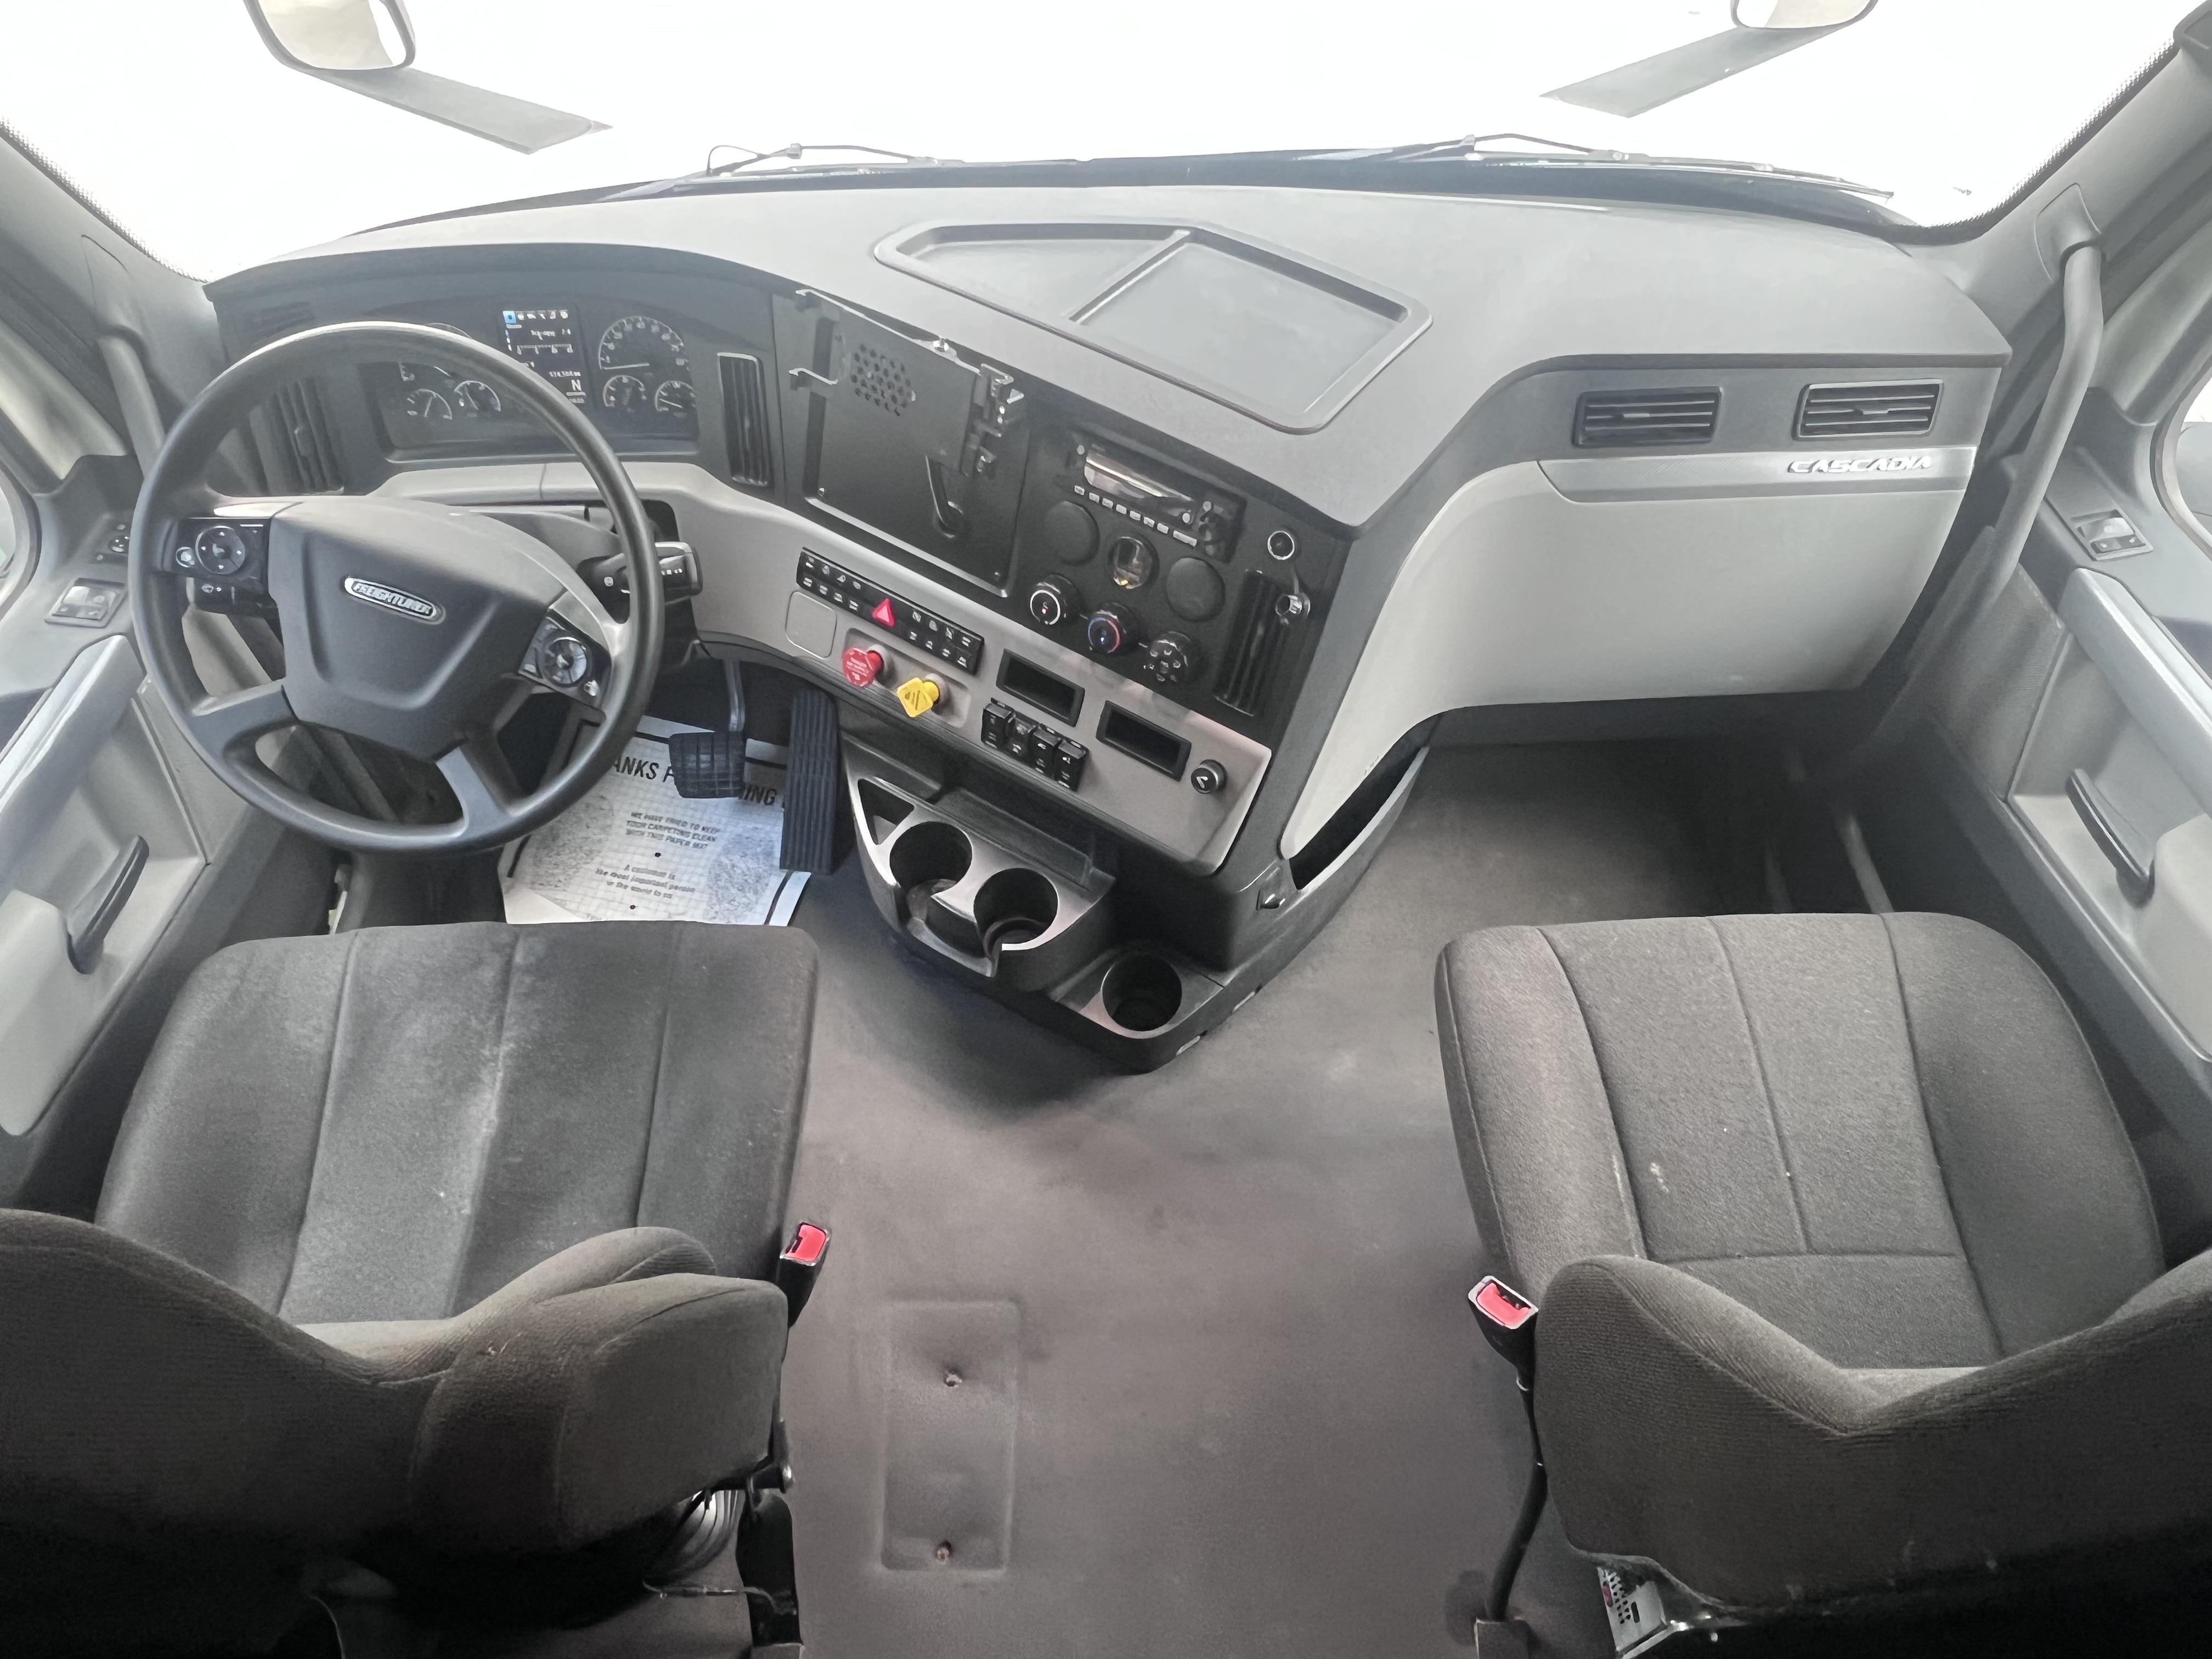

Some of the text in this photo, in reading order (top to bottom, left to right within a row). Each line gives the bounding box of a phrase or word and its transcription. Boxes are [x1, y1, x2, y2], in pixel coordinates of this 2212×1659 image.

[571, 379, 582, 391] N
[1787, 455, 1932, 473] CASCADIA
[613, 756, 659, 780] ANKS
